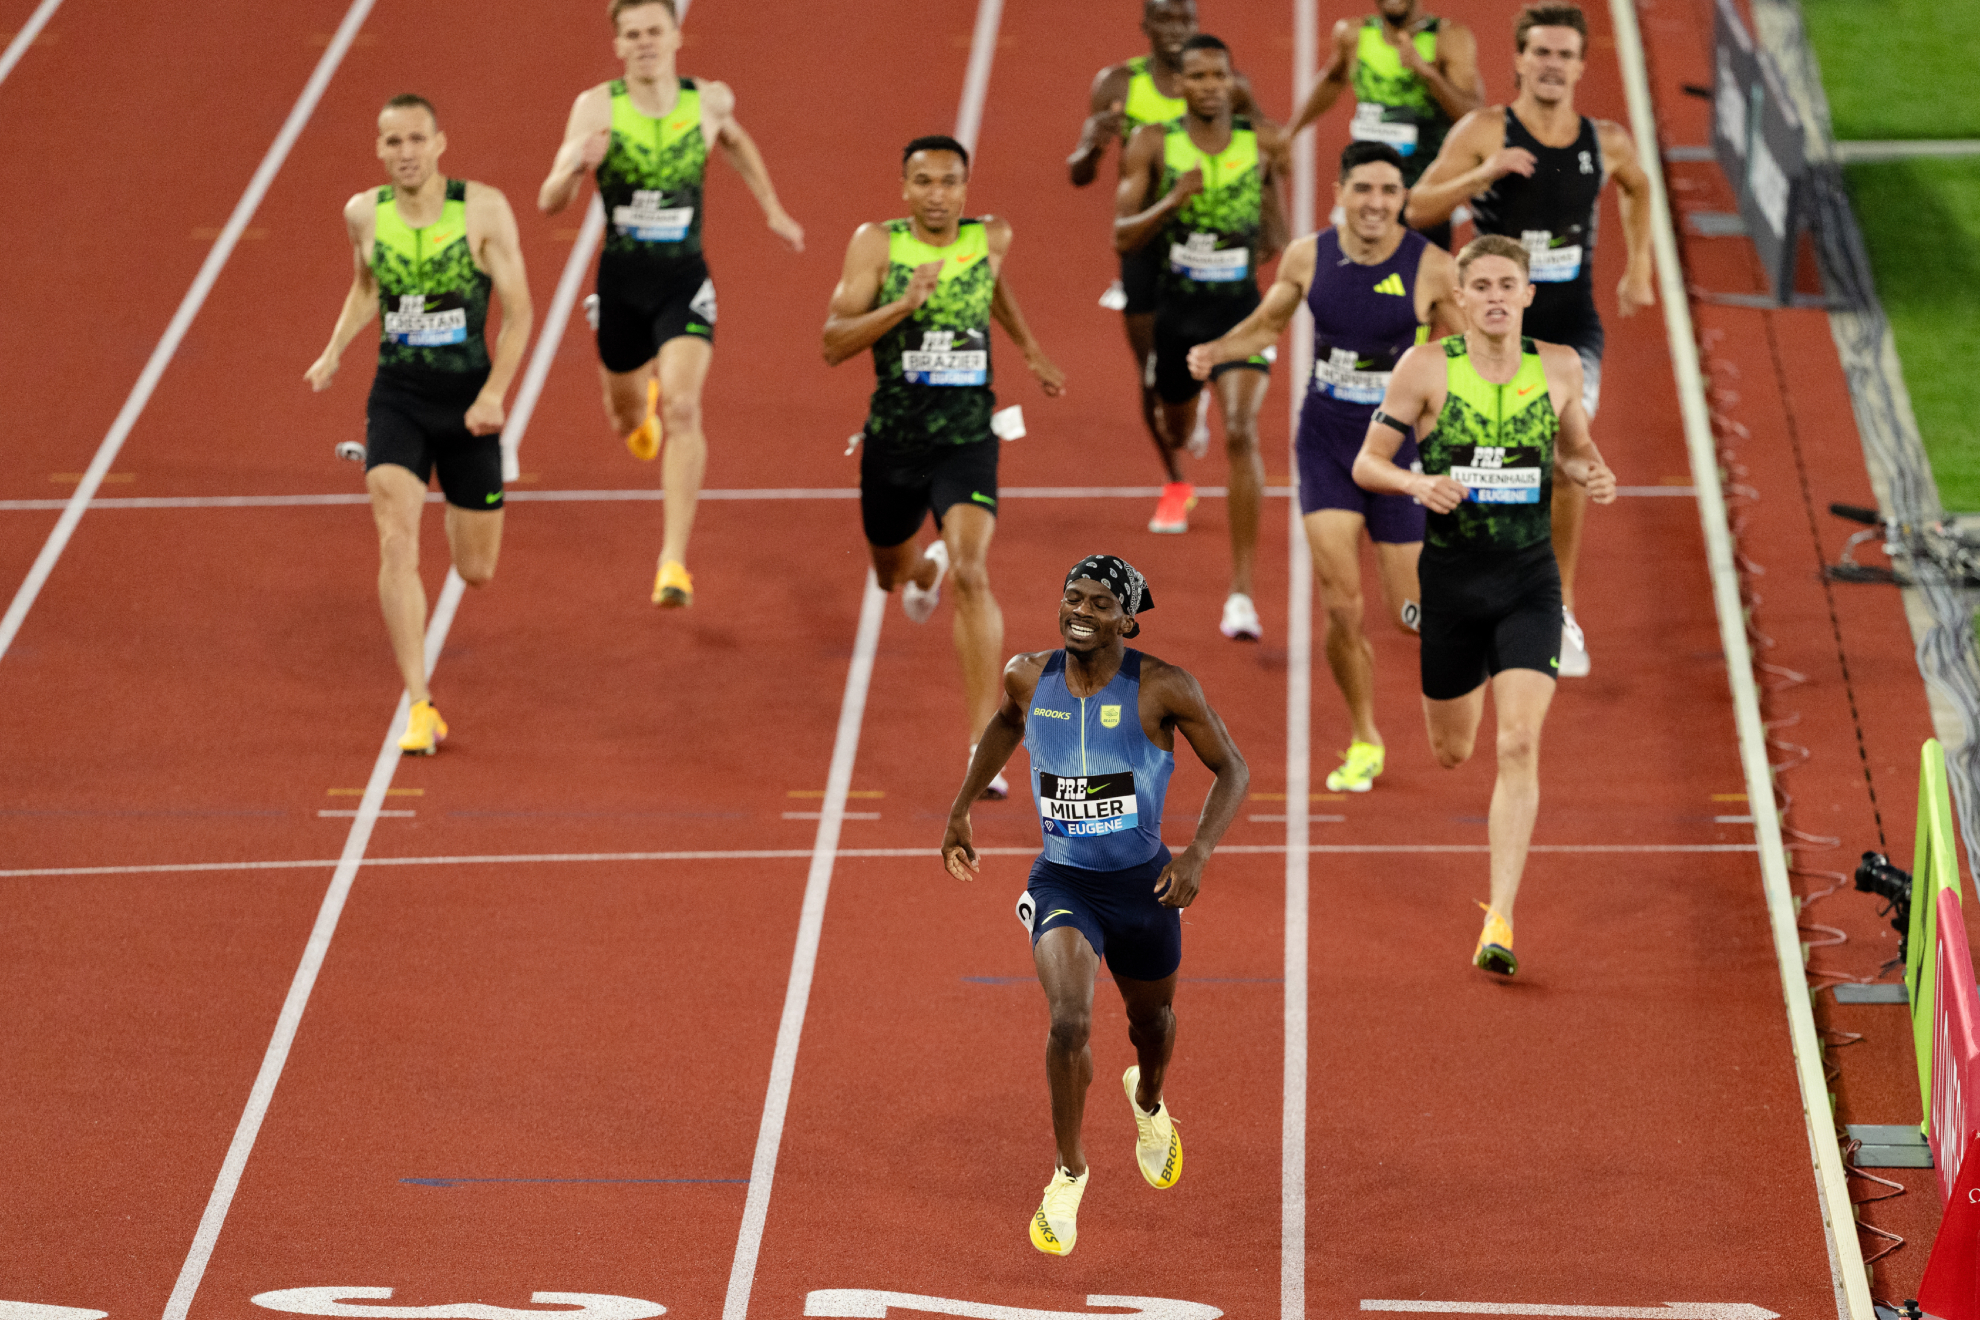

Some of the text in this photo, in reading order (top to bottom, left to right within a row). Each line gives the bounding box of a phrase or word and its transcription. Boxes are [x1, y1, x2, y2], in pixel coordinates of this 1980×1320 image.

[909, 354, 980, 368] BRAZIER
[1471, 446, 1506, 468] PRE
[1454, 471, 1536, 485] LUTKENHAUS
[1477, 489, 1527, 502] EUGENE
[1033, 707, 1072, 721] BROOKS
[1056, 777, 1088, 800] PRE
[1050, 799, 1124, 820] MILLER
[1067, 818, 1123, 836] EUGENE
